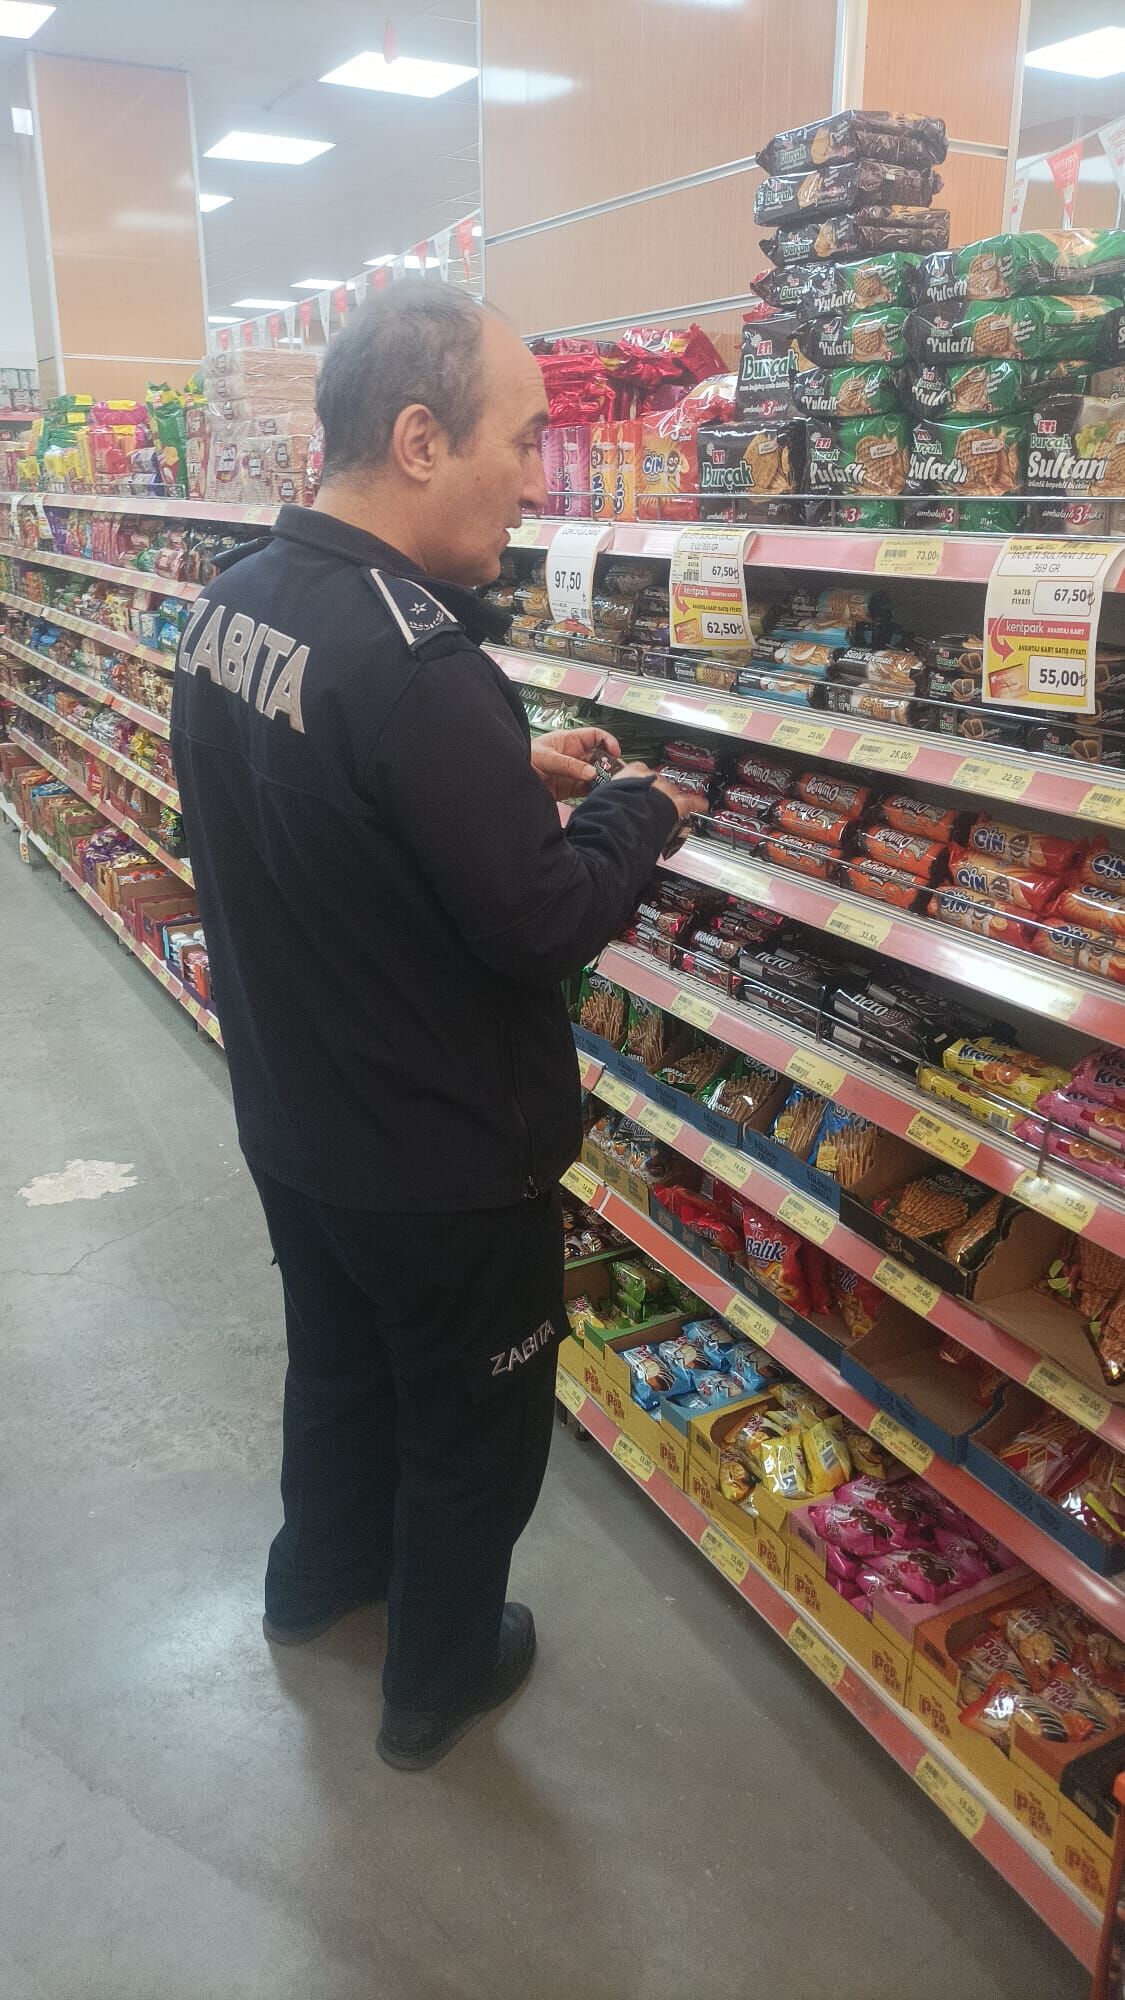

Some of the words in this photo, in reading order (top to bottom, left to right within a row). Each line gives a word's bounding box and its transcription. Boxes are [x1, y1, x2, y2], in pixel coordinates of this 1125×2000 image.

[927, 337, 975, 353] Yulaflı
[1030, 434, 1073, 451] Burçak
[702, 460, 756, 490] Burçak
[944, 507, 954, 523] 3
[1073, 505, 1084, 524] 3
[1033, 563, 1048, 572] 369
[1048, 564, 1060, 572] GR
[554, 570, 582, 592] 97,50
[1006, 618, 1044, 637] kentpark
[1040, 646, 1055, 654] KART
[178, 597, 311, 734] ZABITA
[851, 993, 889, 1017] nero
[490, 1319, 555, 1376] ZABITA
